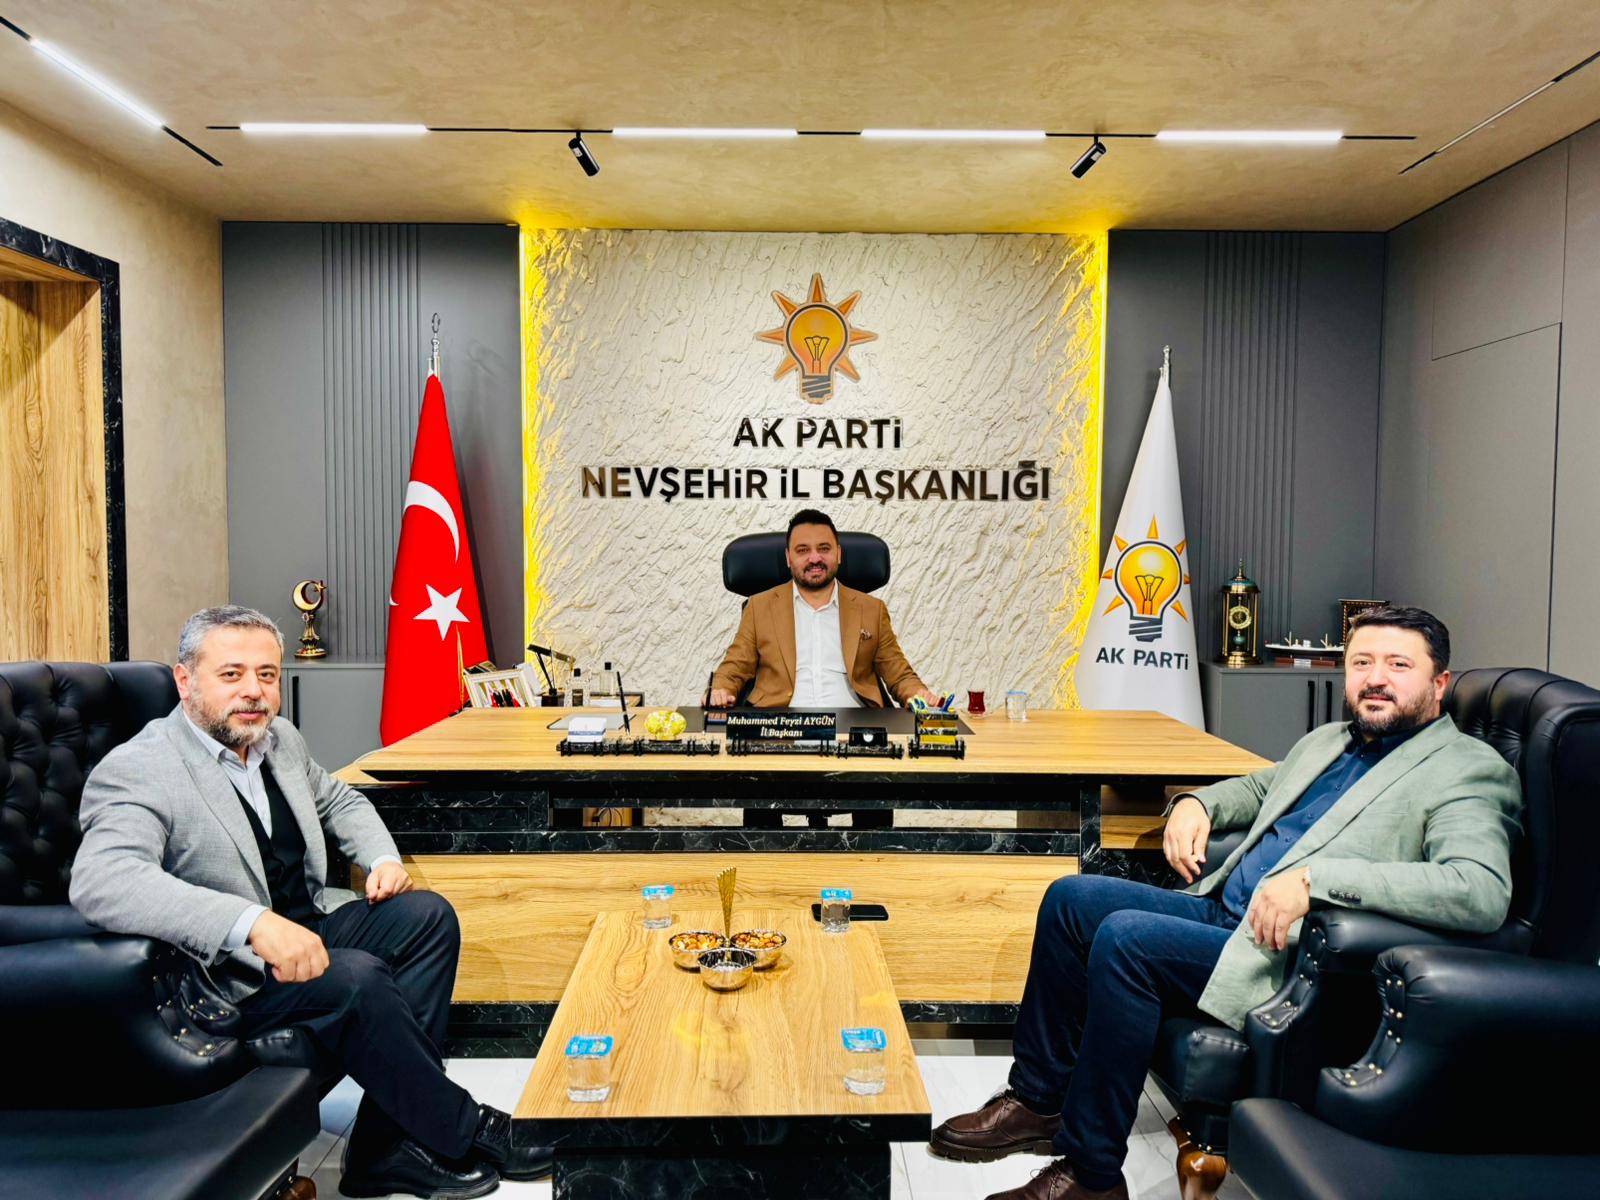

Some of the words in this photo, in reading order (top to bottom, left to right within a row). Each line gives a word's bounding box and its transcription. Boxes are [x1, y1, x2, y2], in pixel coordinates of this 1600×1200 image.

[733, 418, 784, 448] AK
[823, 461, 1051, 505] BAŞKANLIĞI
[1095, 647, 1127, 665] AK
[727, 716, 778, 725] Muhammed
[780, 717, 802, 727] Feyzi
[804, 715, 835, 725] AYGÜN
[769, 728, 803, 738] Başkanı
